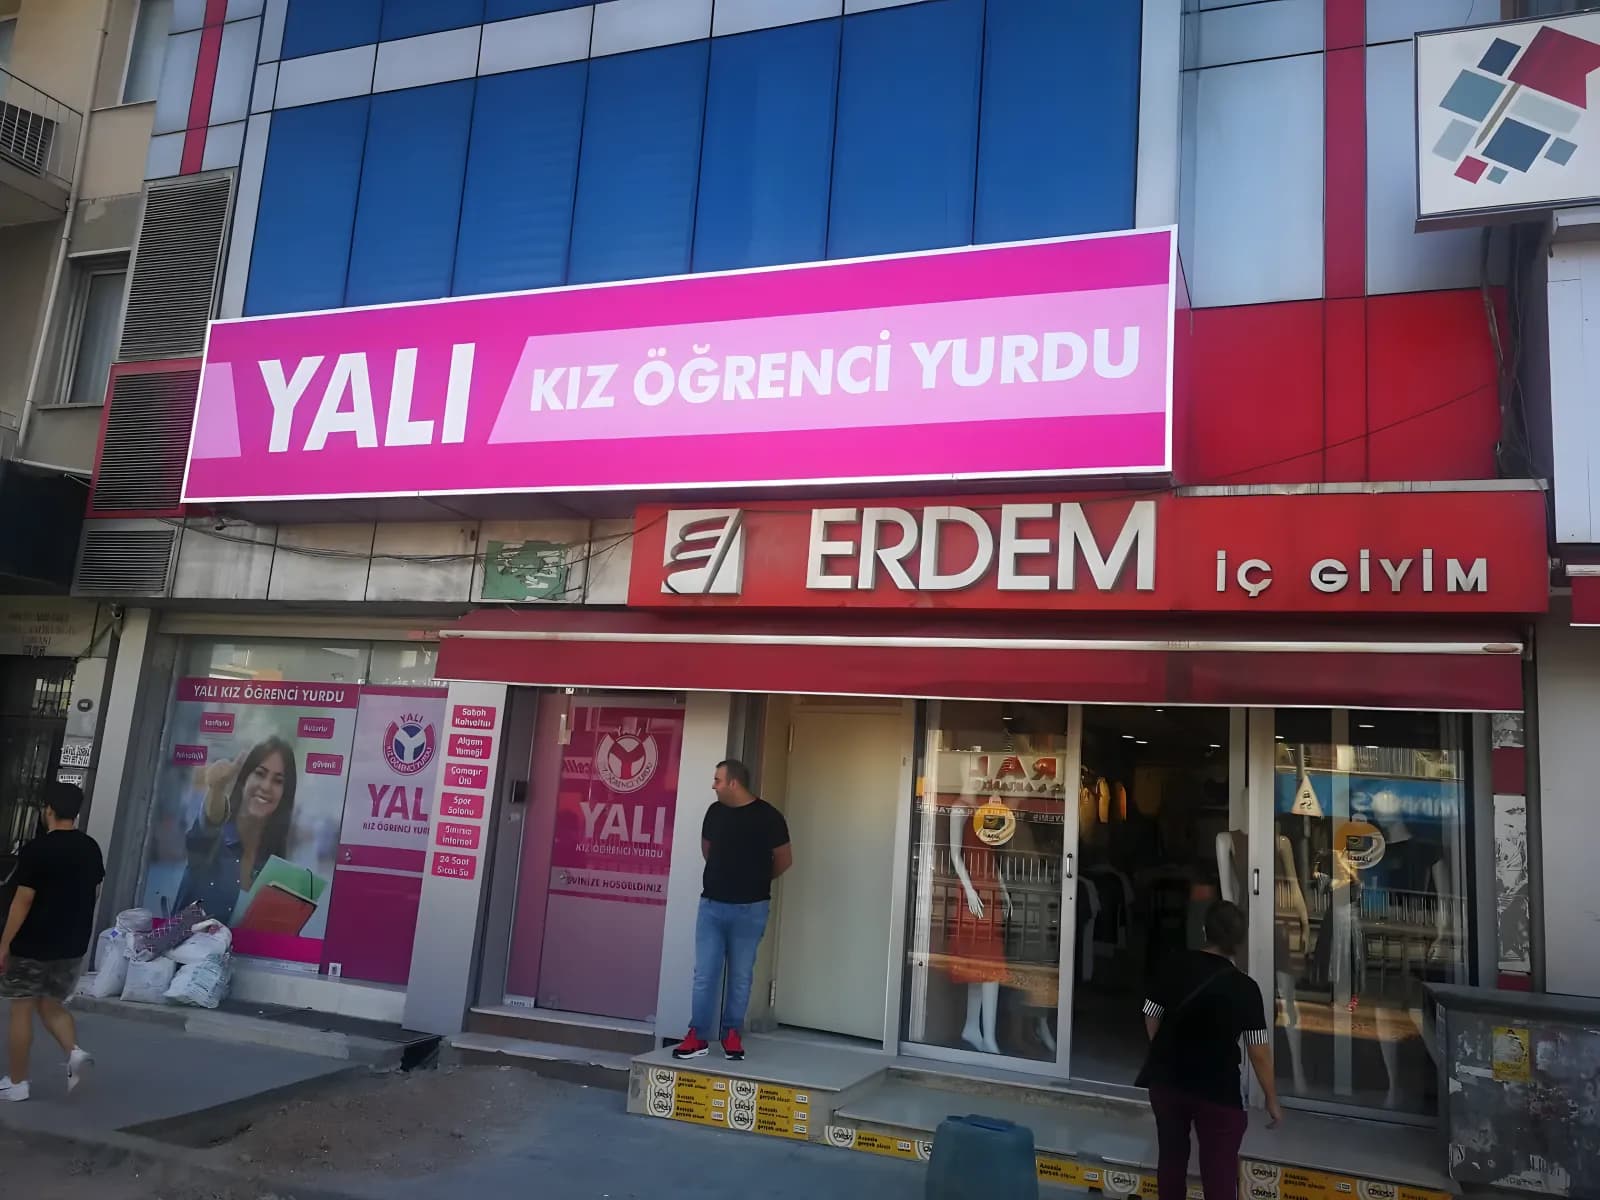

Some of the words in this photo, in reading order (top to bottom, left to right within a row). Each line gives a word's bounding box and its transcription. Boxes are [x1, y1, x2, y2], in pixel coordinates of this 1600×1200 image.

[257, 343, 475, 453] YALI
[530, 363, 619, 411] KIZ
[633, 329, 891, 406] ÖĞRENCİ
[910, 326, 1140, 389] YURDU
[806, 500, 1156, 591] ERDEM
[1216, 550, 1273, 597] İÇ
[1310, 548, 1488, 593] GİYİM
[194, 684, 218, 697] YALI
[221, 686, 241, 698] KIZ
[244, 684, 298, 701] ÖĞRENCİ
[301, 688, 345, 703] YURDU
[399, 713, 424, 723] YALI
[367, 783, 429, 822] YAL
[578, 802, 666, 845] YALI
